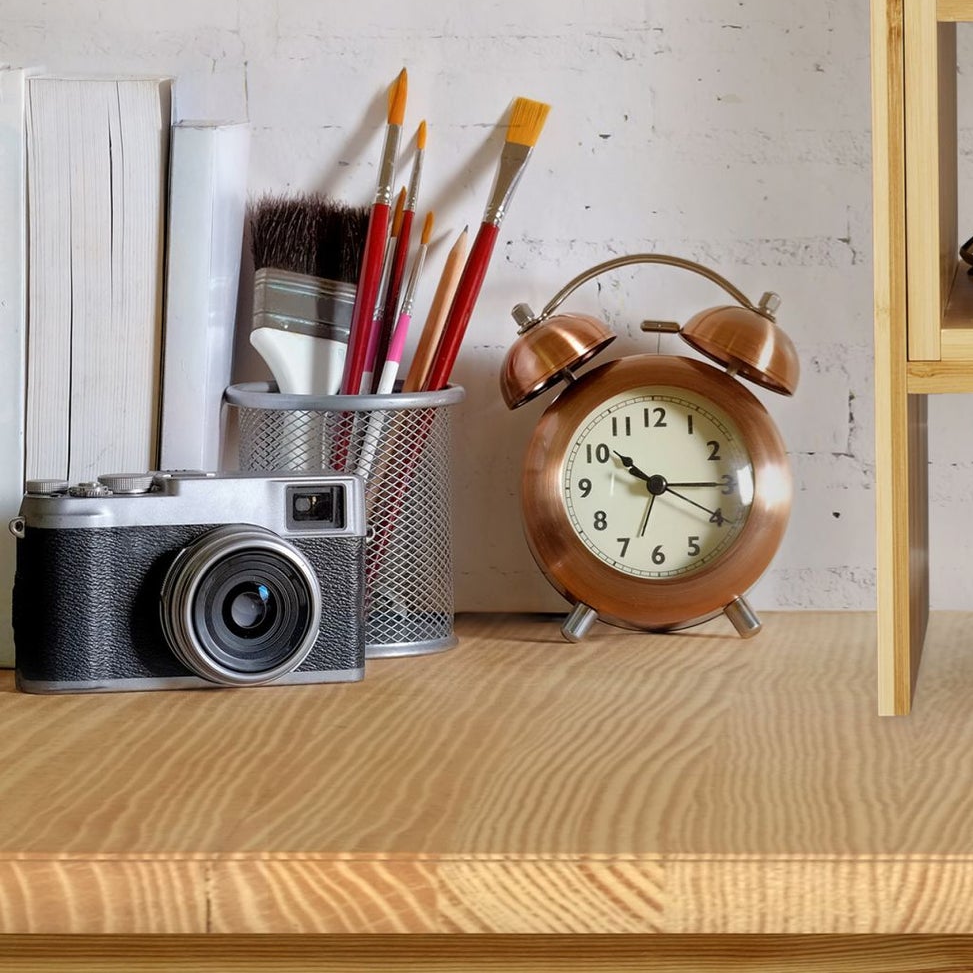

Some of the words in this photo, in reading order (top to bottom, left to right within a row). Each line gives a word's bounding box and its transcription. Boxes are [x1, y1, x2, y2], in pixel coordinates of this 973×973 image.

[612, 416, 631, 436] 11
[643, 407, 667, 428] 12
[687, 414, 694, 435] 1
[586, 443, 610, 464] 10
[706, 440, 721, 461] 2
[578, 478, 592, 498] 9
[721, 474, 735, 495] 3
[593, 510, 608, 531] 8
[709, 508, 724, 527] 4
[617, 537, 630, 558] 7
[651, 545, 666, 565] 6
[687, 536, 700, 557] 5
